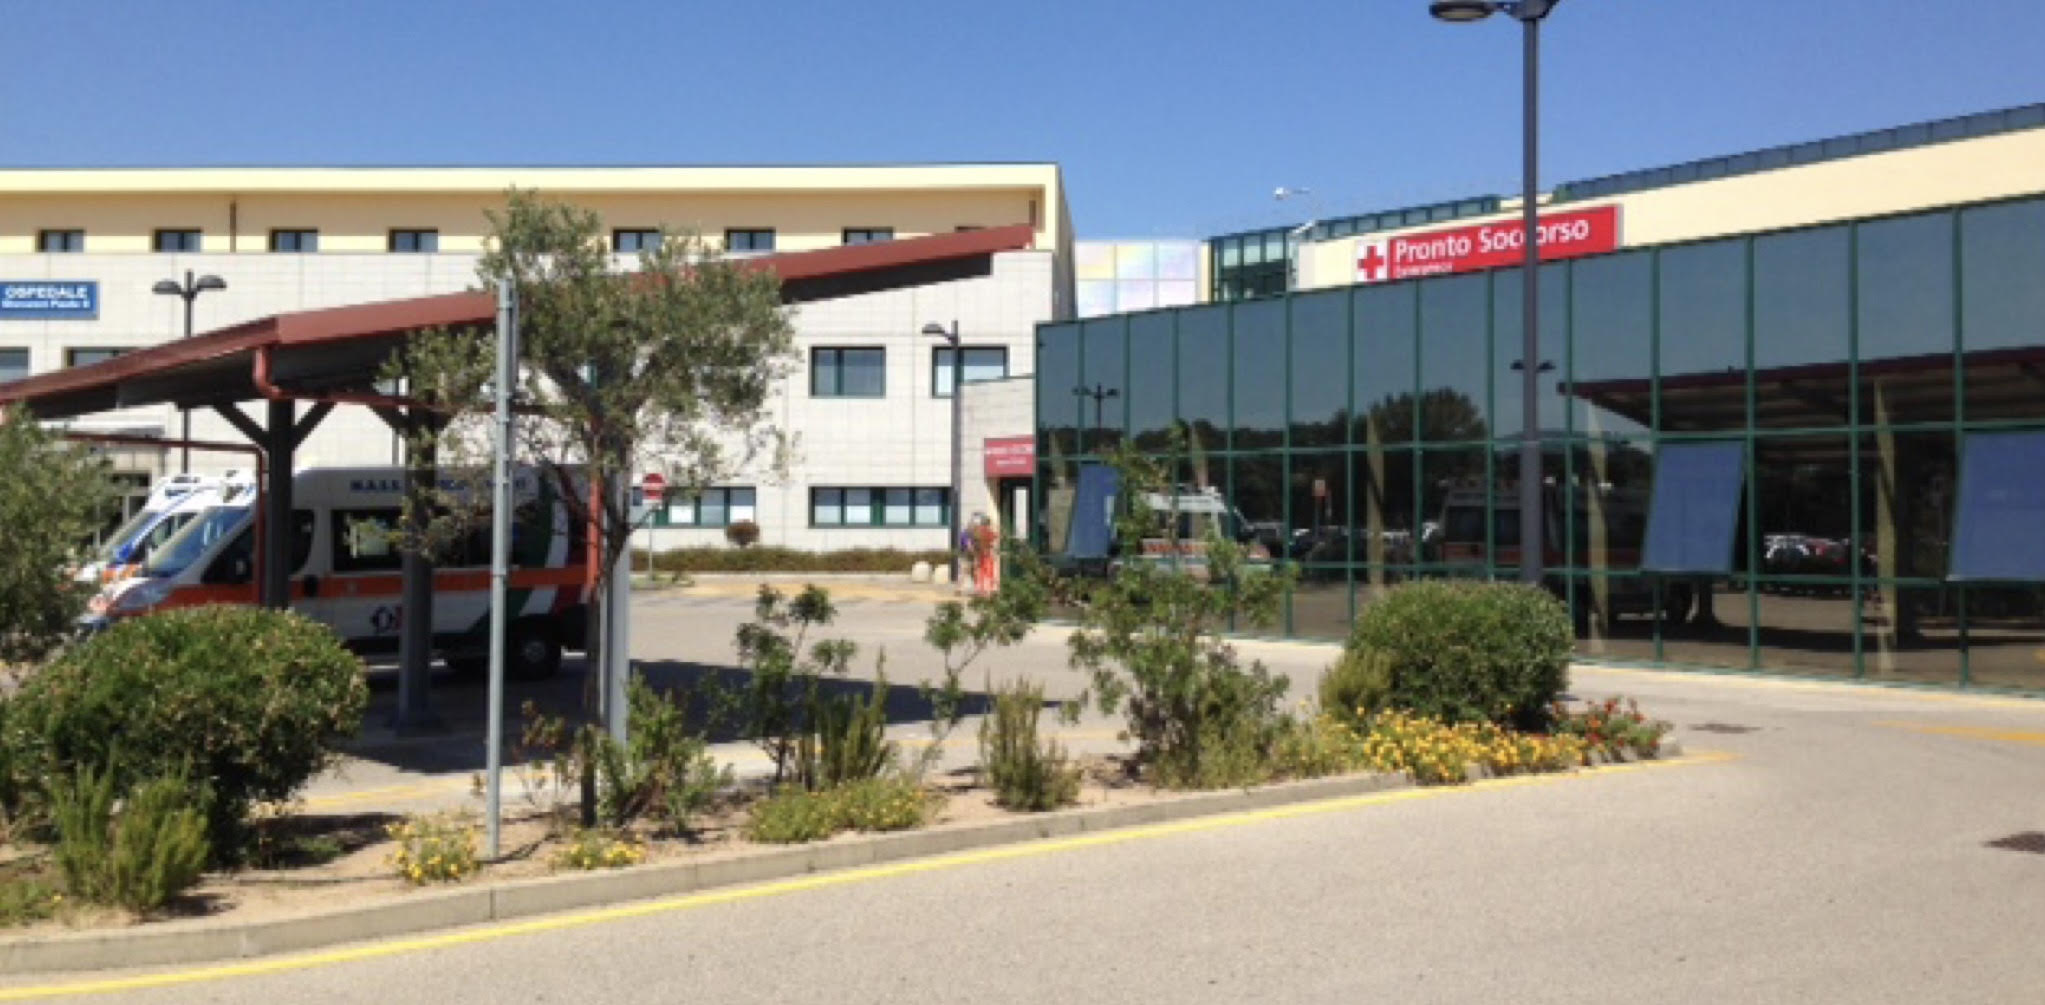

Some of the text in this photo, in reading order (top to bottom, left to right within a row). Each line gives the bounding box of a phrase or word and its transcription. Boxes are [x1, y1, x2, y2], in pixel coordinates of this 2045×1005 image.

[1395, 219, 1590, 262] Pronto Socorso
[4, 285, 88, 299] OSPEDALE
